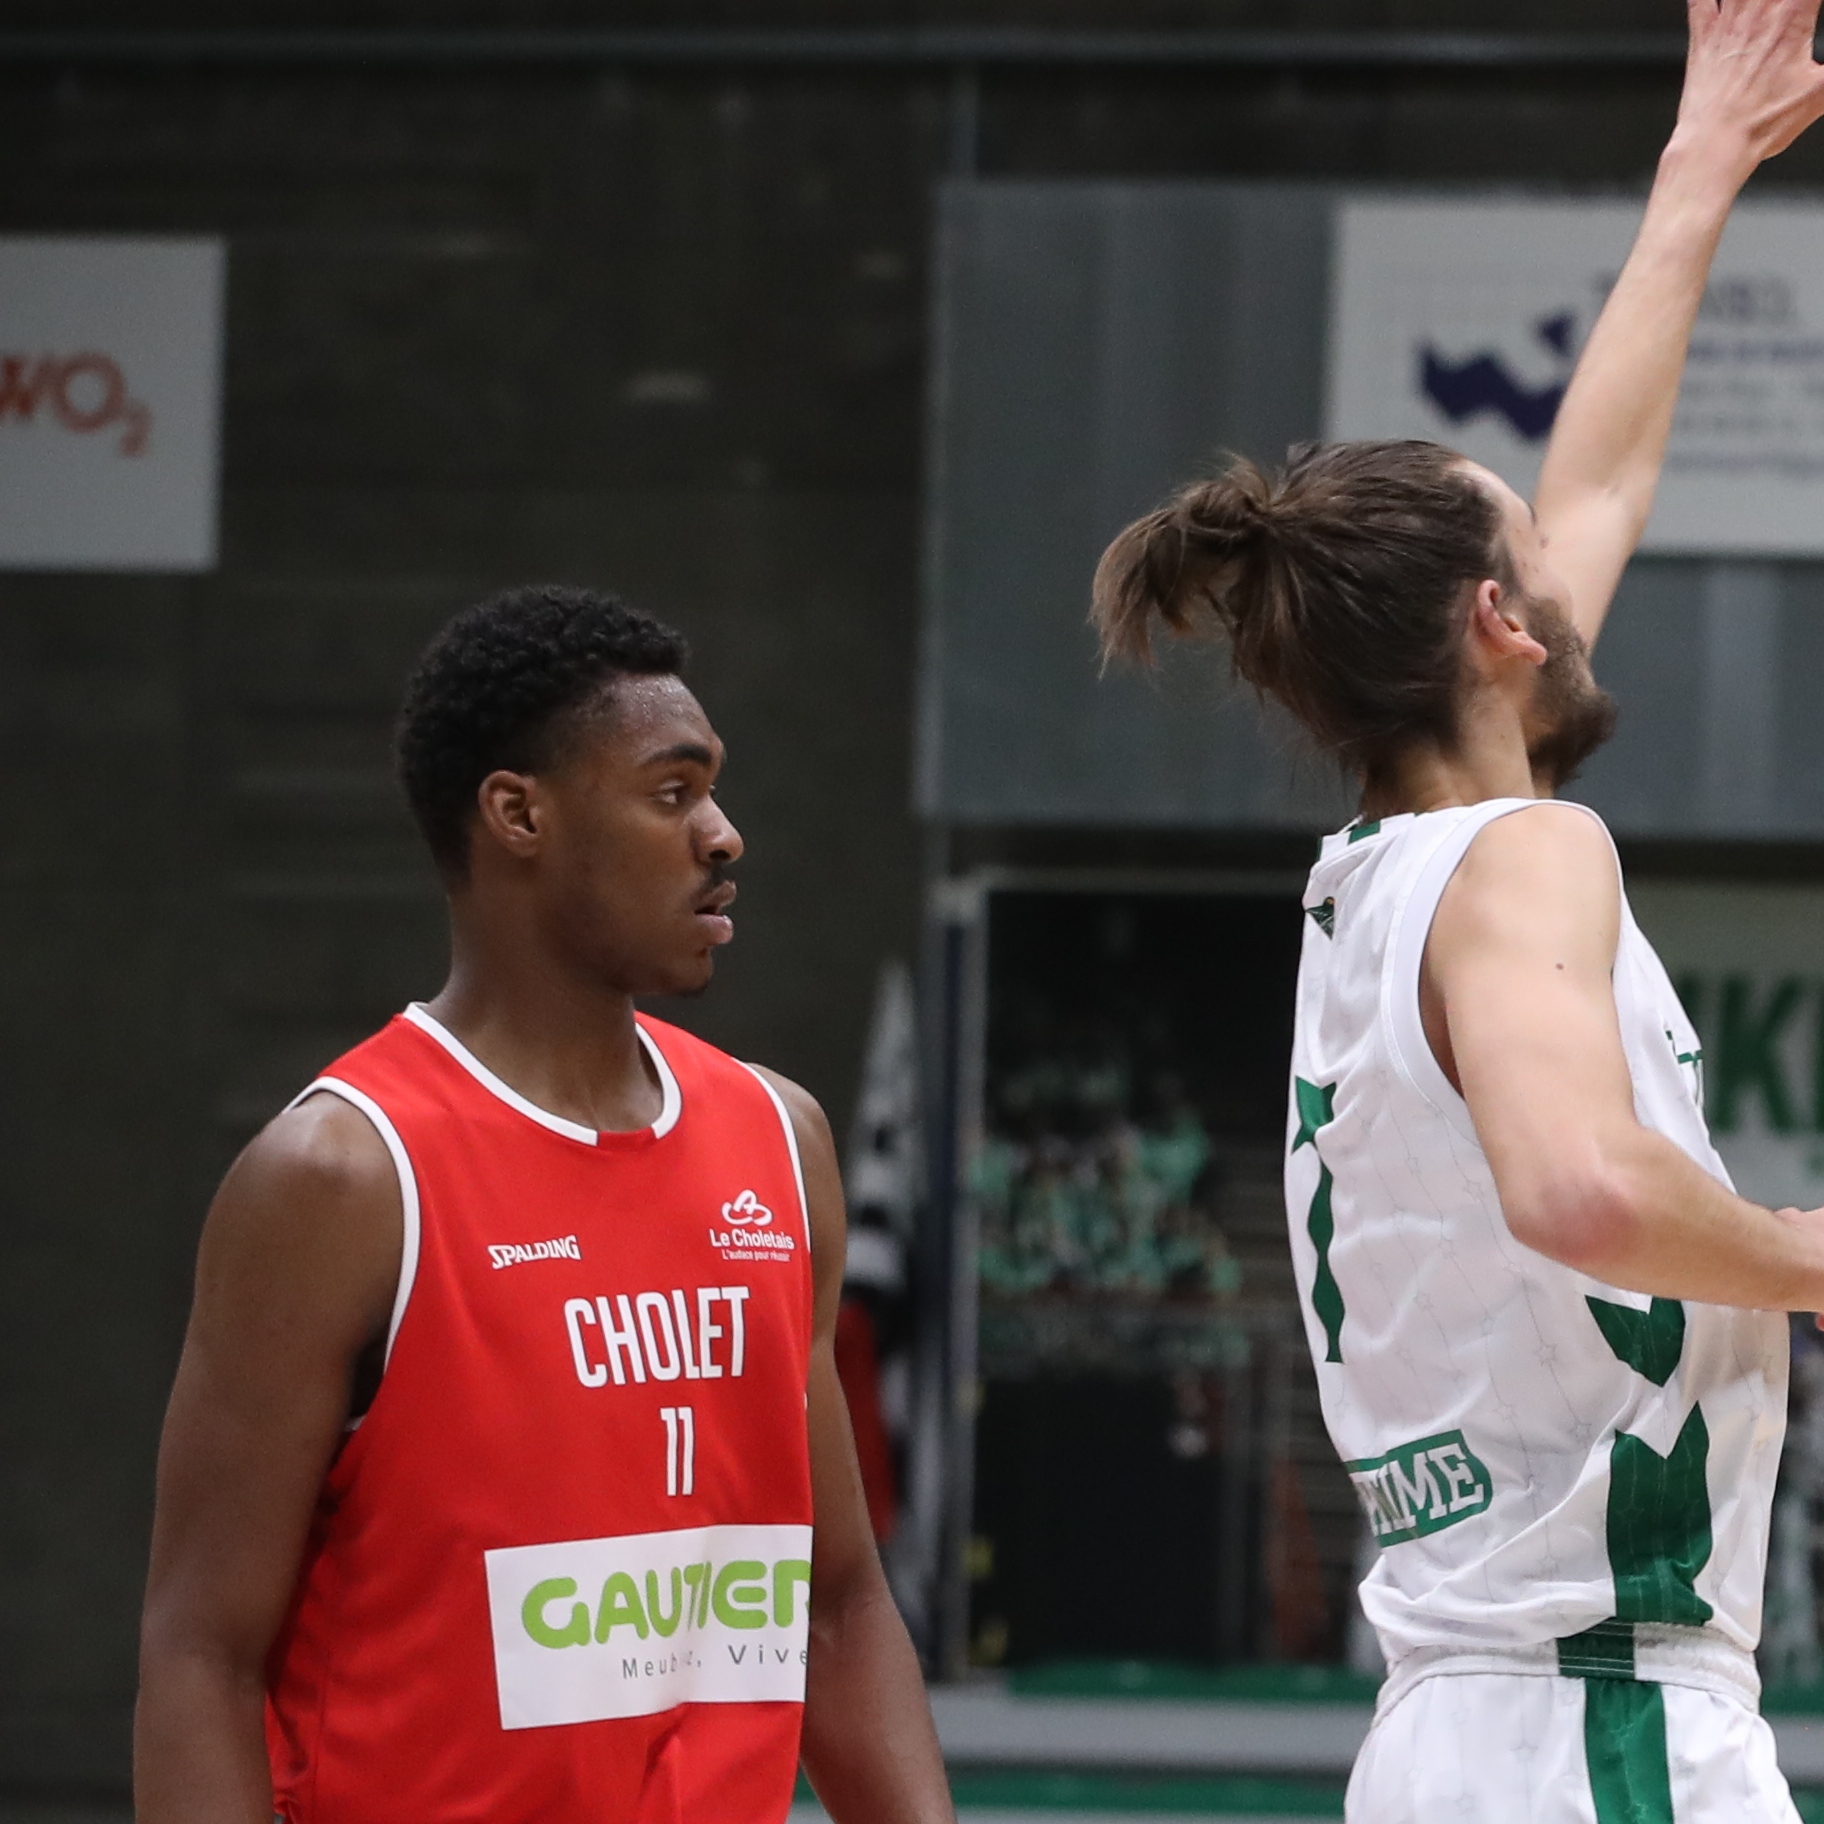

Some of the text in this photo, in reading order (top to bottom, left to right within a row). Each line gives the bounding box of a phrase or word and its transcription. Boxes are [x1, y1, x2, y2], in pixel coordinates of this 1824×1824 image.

[487, 1234, 582, 1270] SPALDING
[709, 1228, 795, 1250] Le Choletais
[564, 1287, 750, 1389] CHOLET
[660, 1407, 694, 1497] 11
